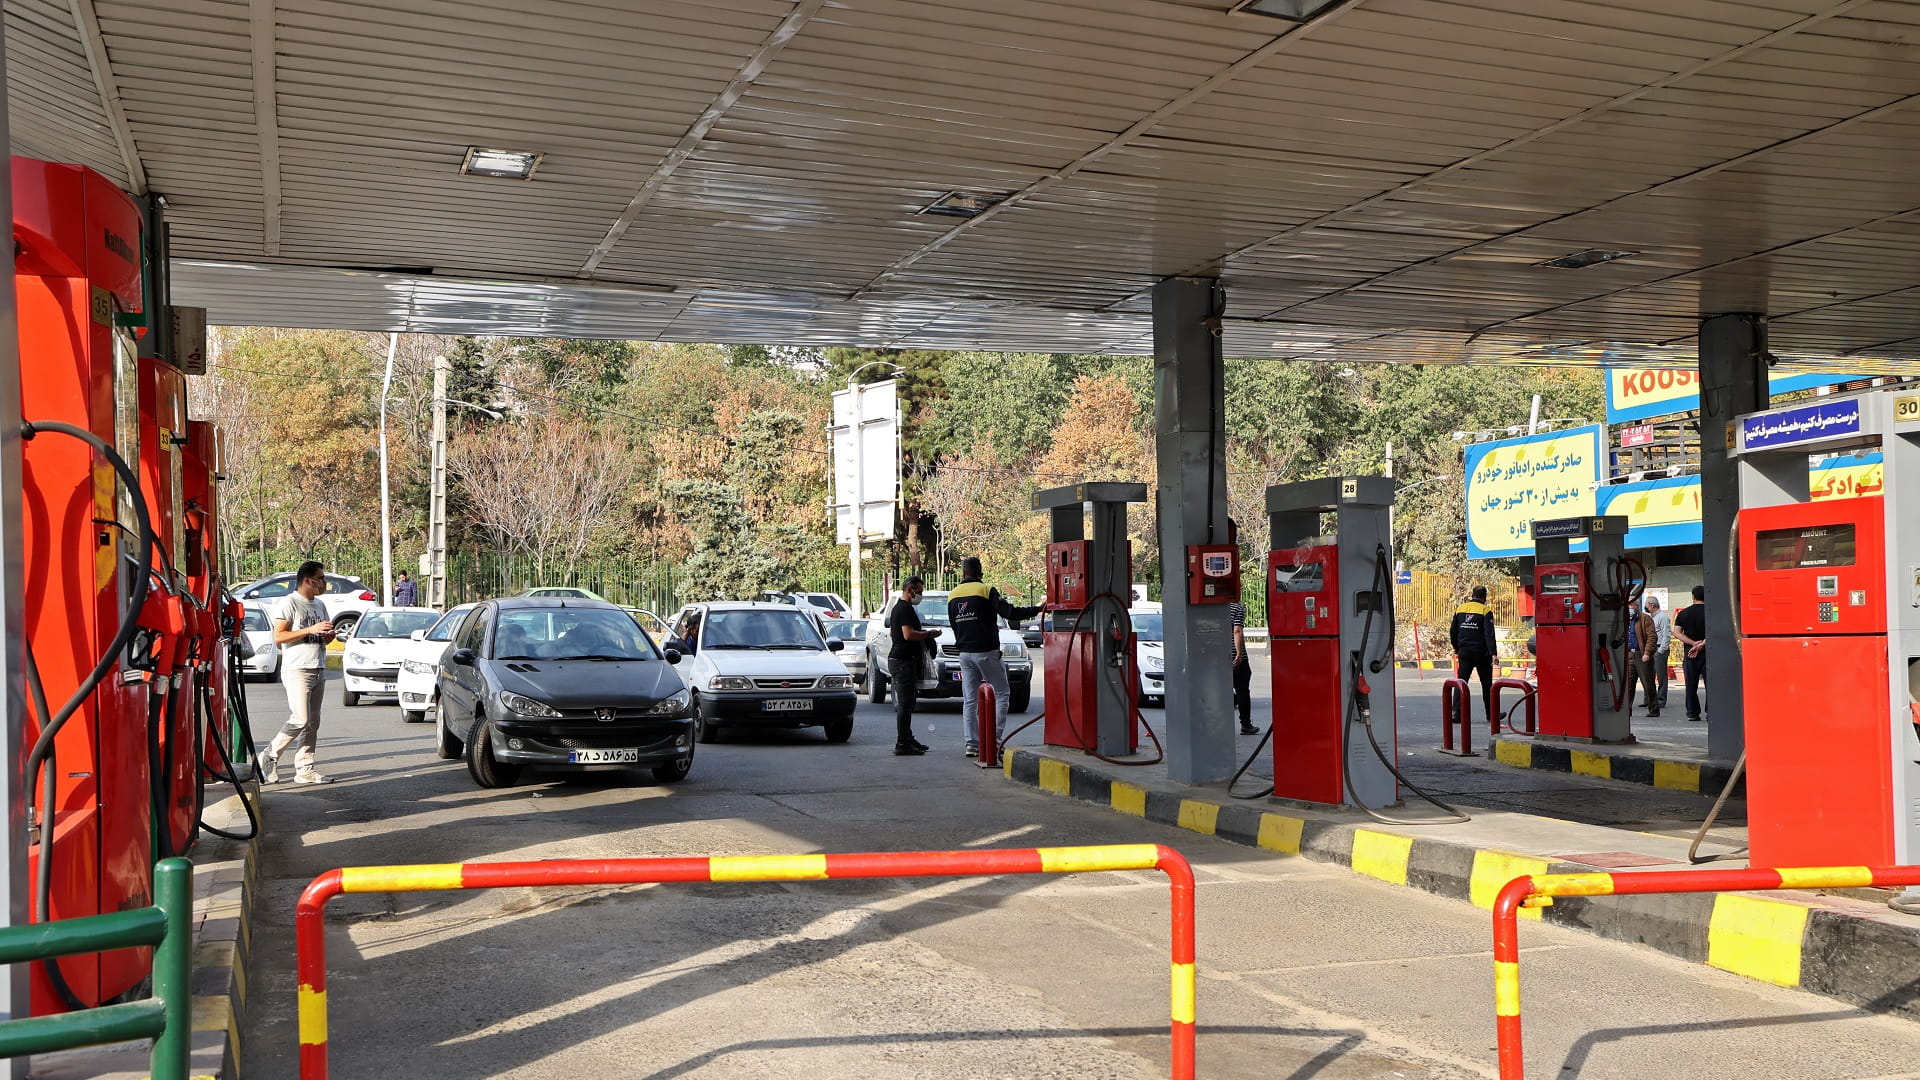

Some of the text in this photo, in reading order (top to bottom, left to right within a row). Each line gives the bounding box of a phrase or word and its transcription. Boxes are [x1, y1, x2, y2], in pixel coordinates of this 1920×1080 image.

[95, 296, 108, 316] 35
[1898, 401, 1919, 415] 30
[1777, 418, 1798, 435] همیشه
[1814, 410, 1836, 430] مصرف
[1835, 411, 1858, 426] درست
[1759, 419, 1778, 440] مصرف
[161, 433, 169, 445] 33
[1536, 455, 1560, 471] کننده
[1560, 453, 1582, 473] صادر
[1477, 464, 1503, 484] خودرو
[1344, 484, 1355, 493] 28
[1481, 486, 1579, 512] به بیش از ۳۰ کشور جهان
[1510, 519, 1527, 539] قاره
[1593, 521, 1603, 529] 14
[1800, 530, 1828, 538] AMOUNT
[576, 750, 637, 762] ۳۸ د ۵۸۶ ۵۵
